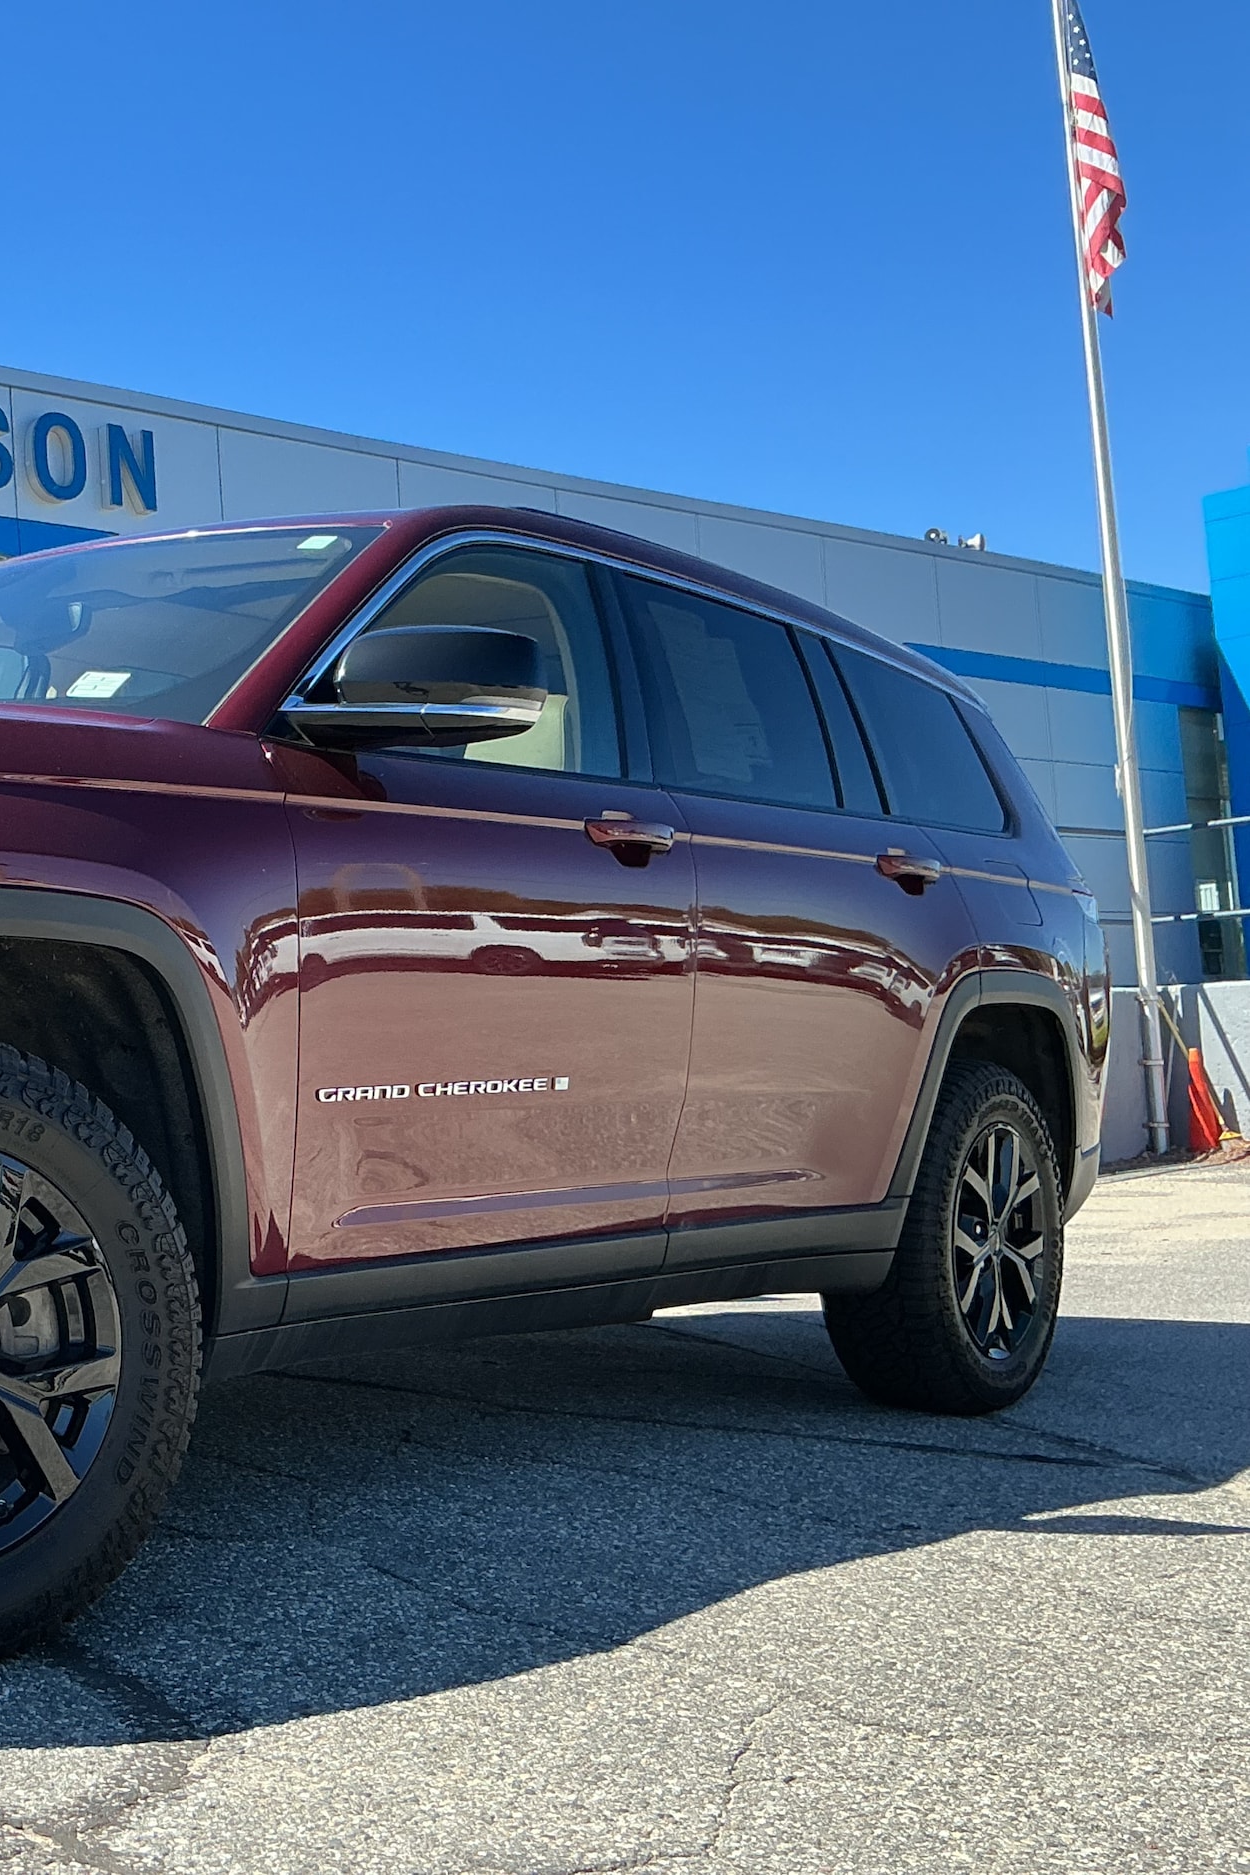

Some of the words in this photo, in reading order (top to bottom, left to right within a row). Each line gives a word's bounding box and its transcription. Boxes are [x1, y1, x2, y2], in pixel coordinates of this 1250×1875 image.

[316, 1083, 410, 1103] GRAND
[415, 1076, 549, 1098] CHEROKEE
[114, 1219, 163, 1487] CROSSWIND
